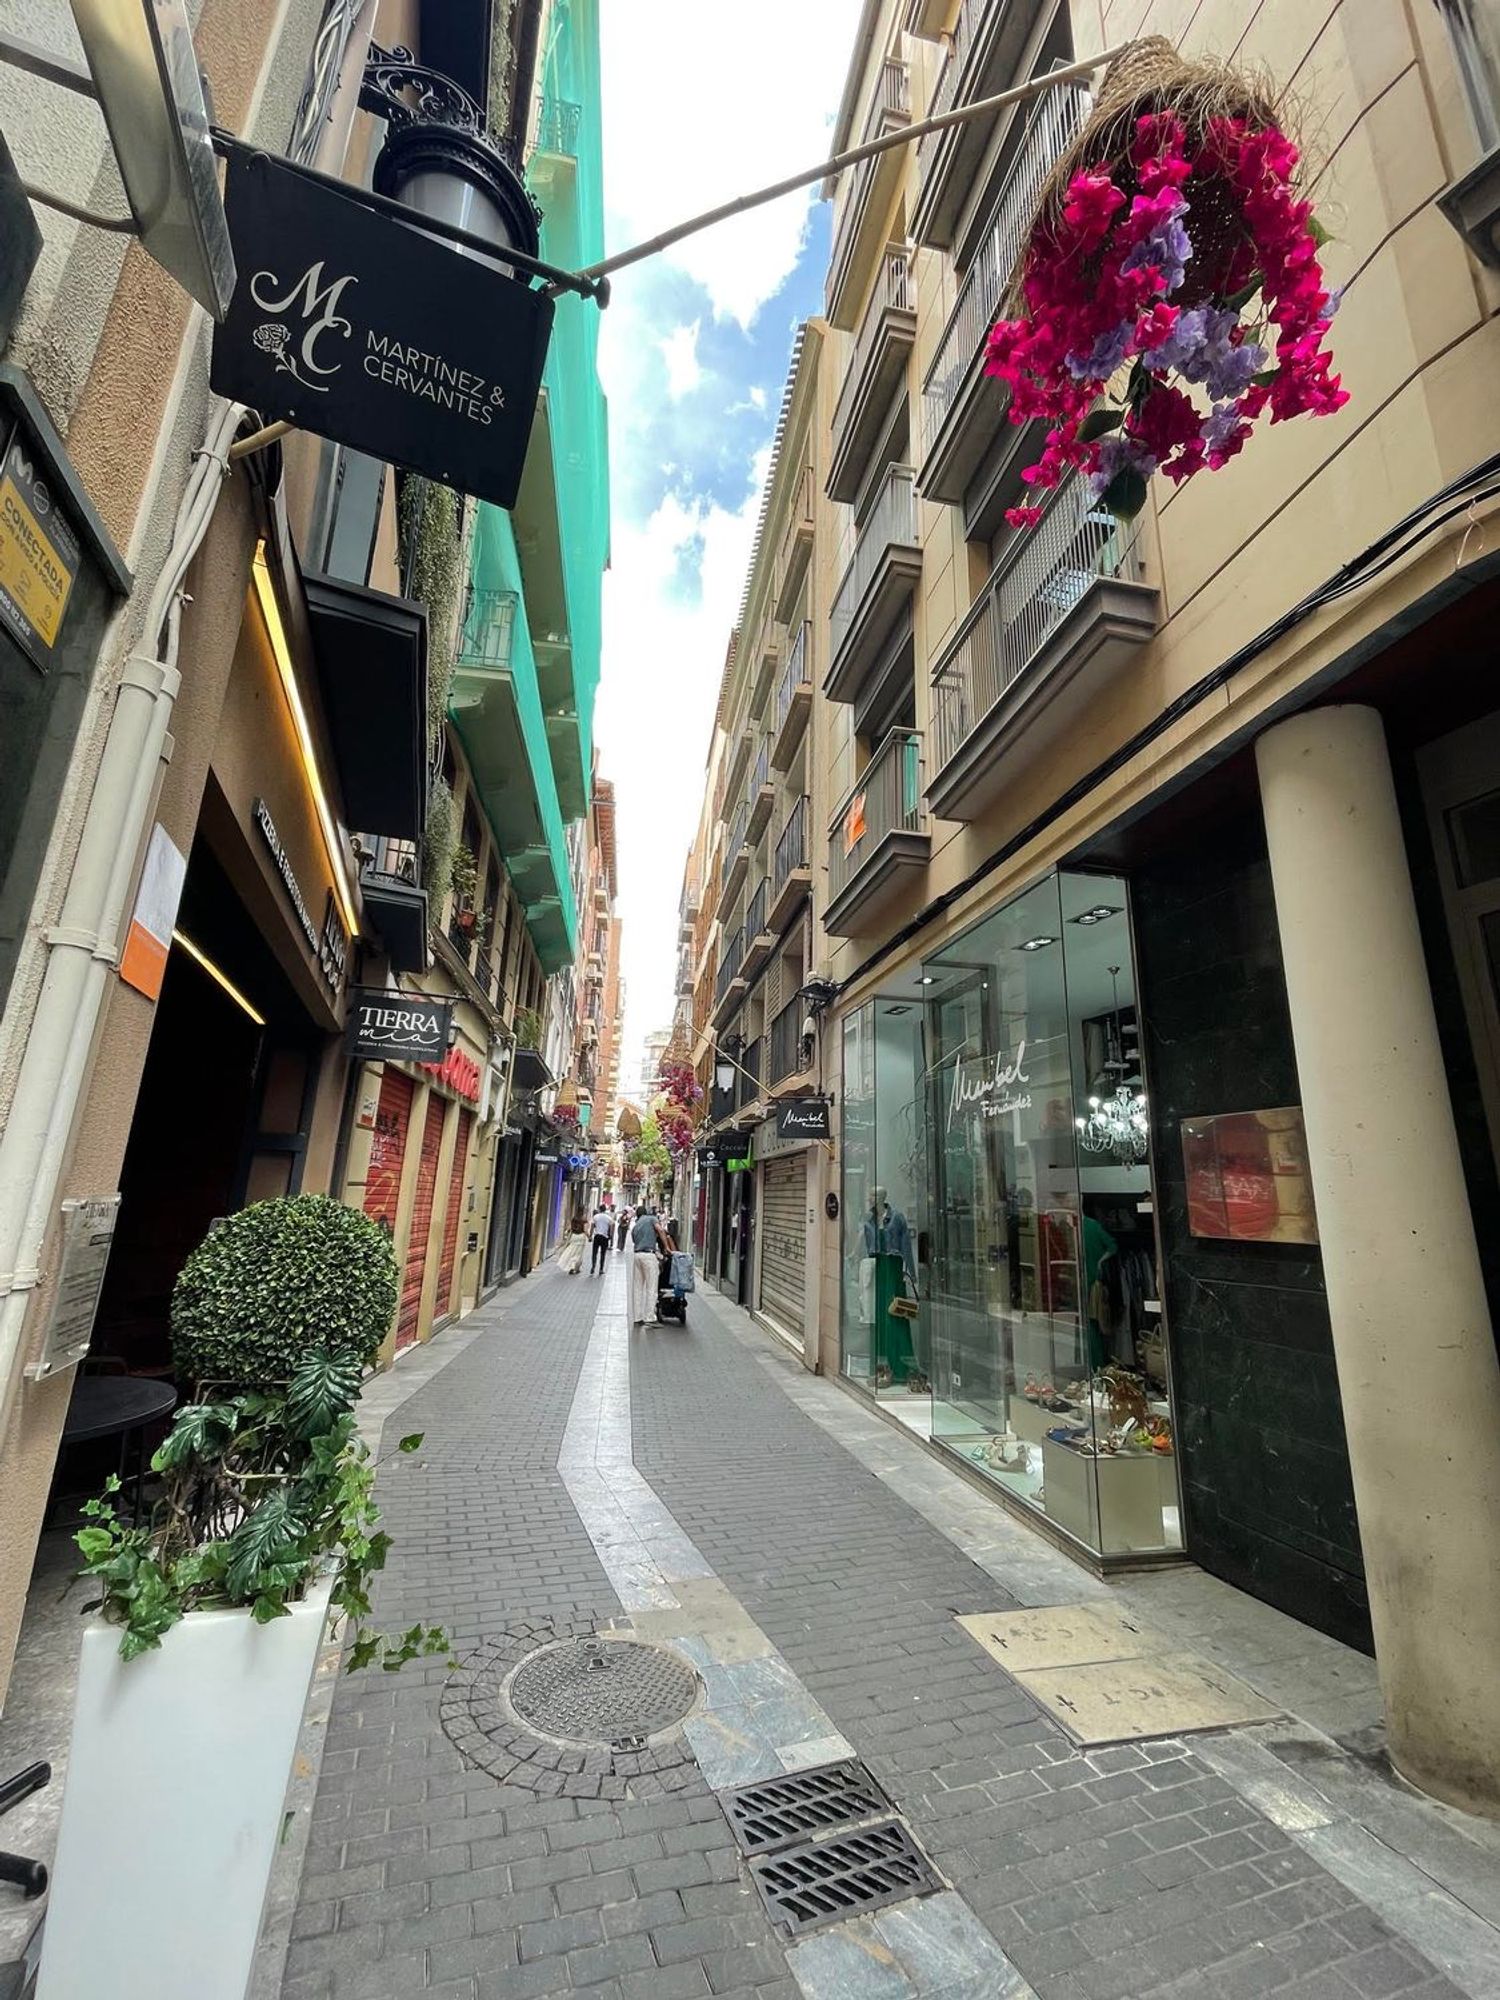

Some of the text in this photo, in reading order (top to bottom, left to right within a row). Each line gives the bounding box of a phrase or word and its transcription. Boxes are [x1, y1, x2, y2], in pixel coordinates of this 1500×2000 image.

[363, 355, 494, 425] CERVANTES
[367, 330, 506, 408] MARTÍNEZ &
[4, 496, 64, 595] CONECTADA
[359, 1006, 441, 1034] TIERRA
[947, 1040, 1029, 1134] Maribel
[980, 1091, 1032, 1118] Fernández
